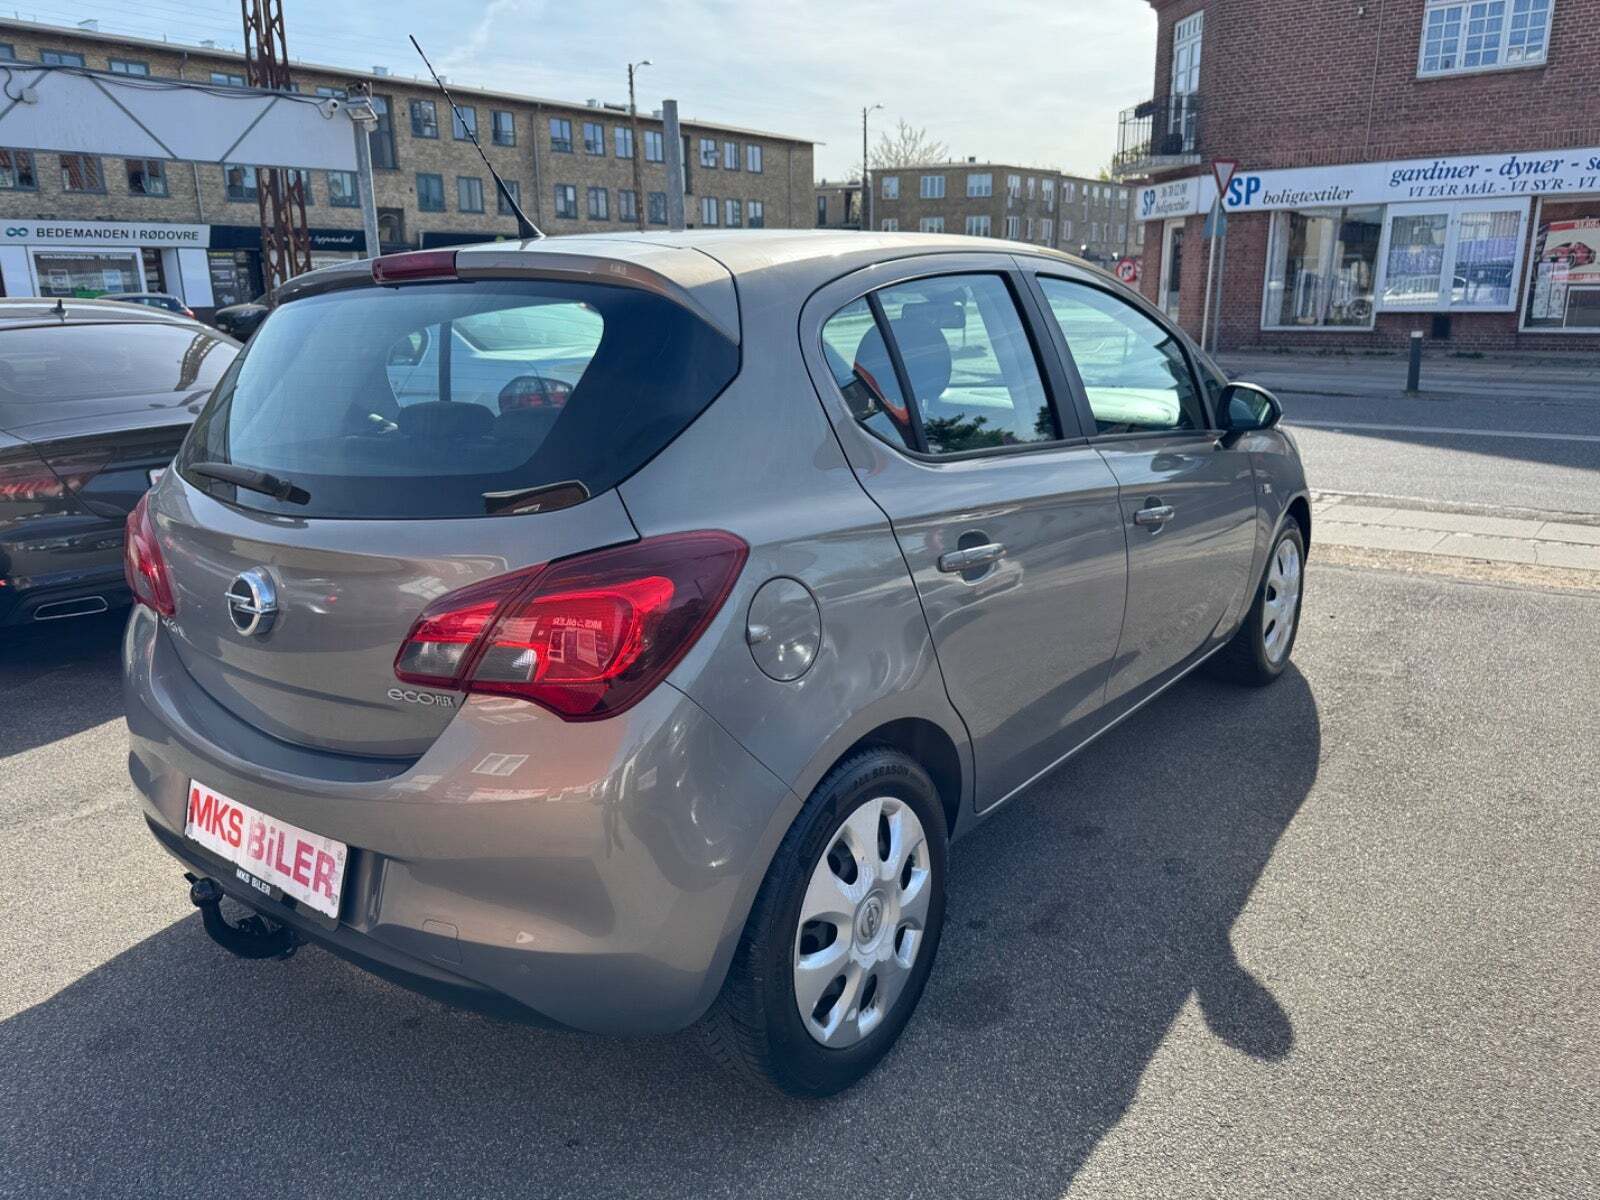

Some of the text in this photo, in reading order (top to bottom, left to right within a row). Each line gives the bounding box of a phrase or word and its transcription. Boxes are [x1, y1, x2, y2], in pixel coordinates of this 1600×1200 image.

[1389, 160, 1480, 187] gardiner
[1499, 156, 1564, 180] dyner
[1227, 176, 1261, 207] SP
[1263, 186, 1354, 206] boligtextiler
[1409, 186, 1424, 197] VI
[1510, 180, 1528, 193] VI
[1579, 176, 1597, 189] VI
[1143, 189, 1156, 215] SP
[36, 227, 199, 241] BEDEMANDEN I RØDOVRE
[188, 788, 244, 848] MKS
[236, 868, 250, 884] MKS
